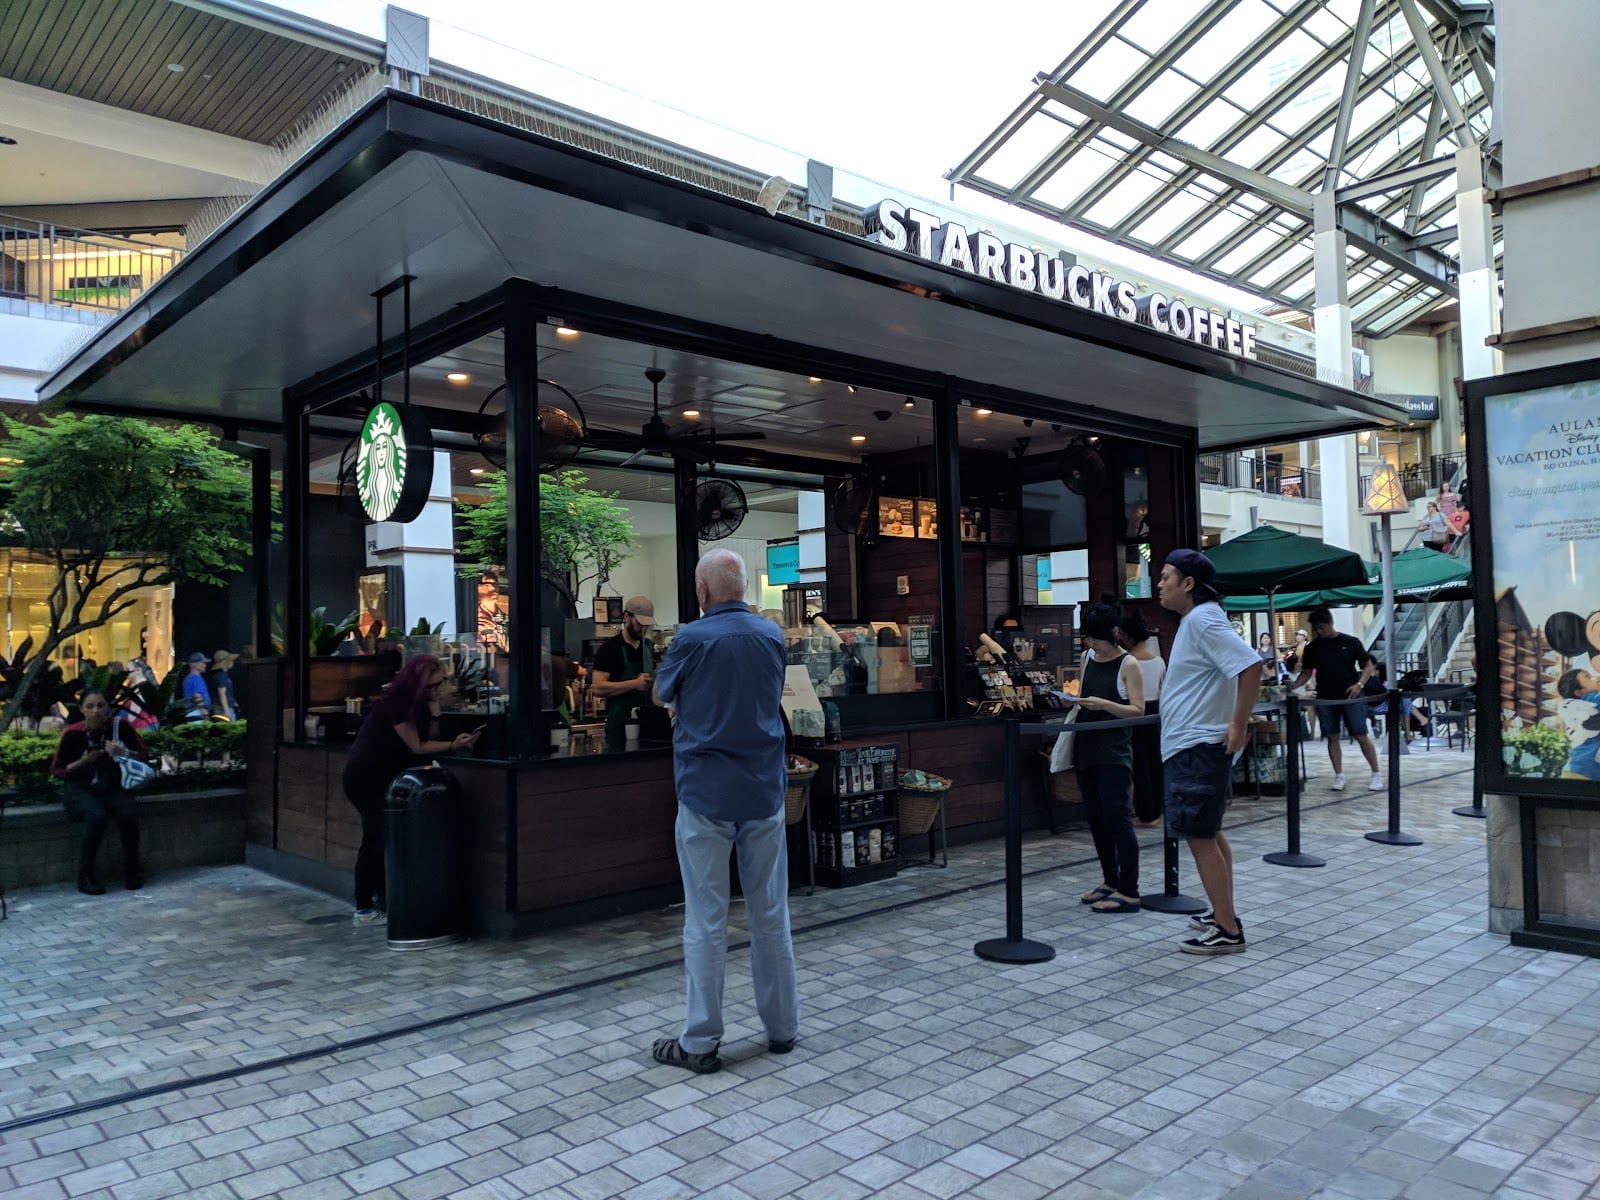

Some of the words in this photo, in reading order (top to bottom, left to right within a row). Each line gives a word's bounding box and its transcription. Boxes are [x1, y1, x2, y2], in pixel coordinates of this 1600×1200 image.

[877, 198, 1138, 323] STARBUCKS
[1149, 293, 1258, 361] COFFEE
[1564, 432, 1599, 444] Disney
[1496, 447, 1572, 466] VACATION
[911, 631, 928, 639] PASS
